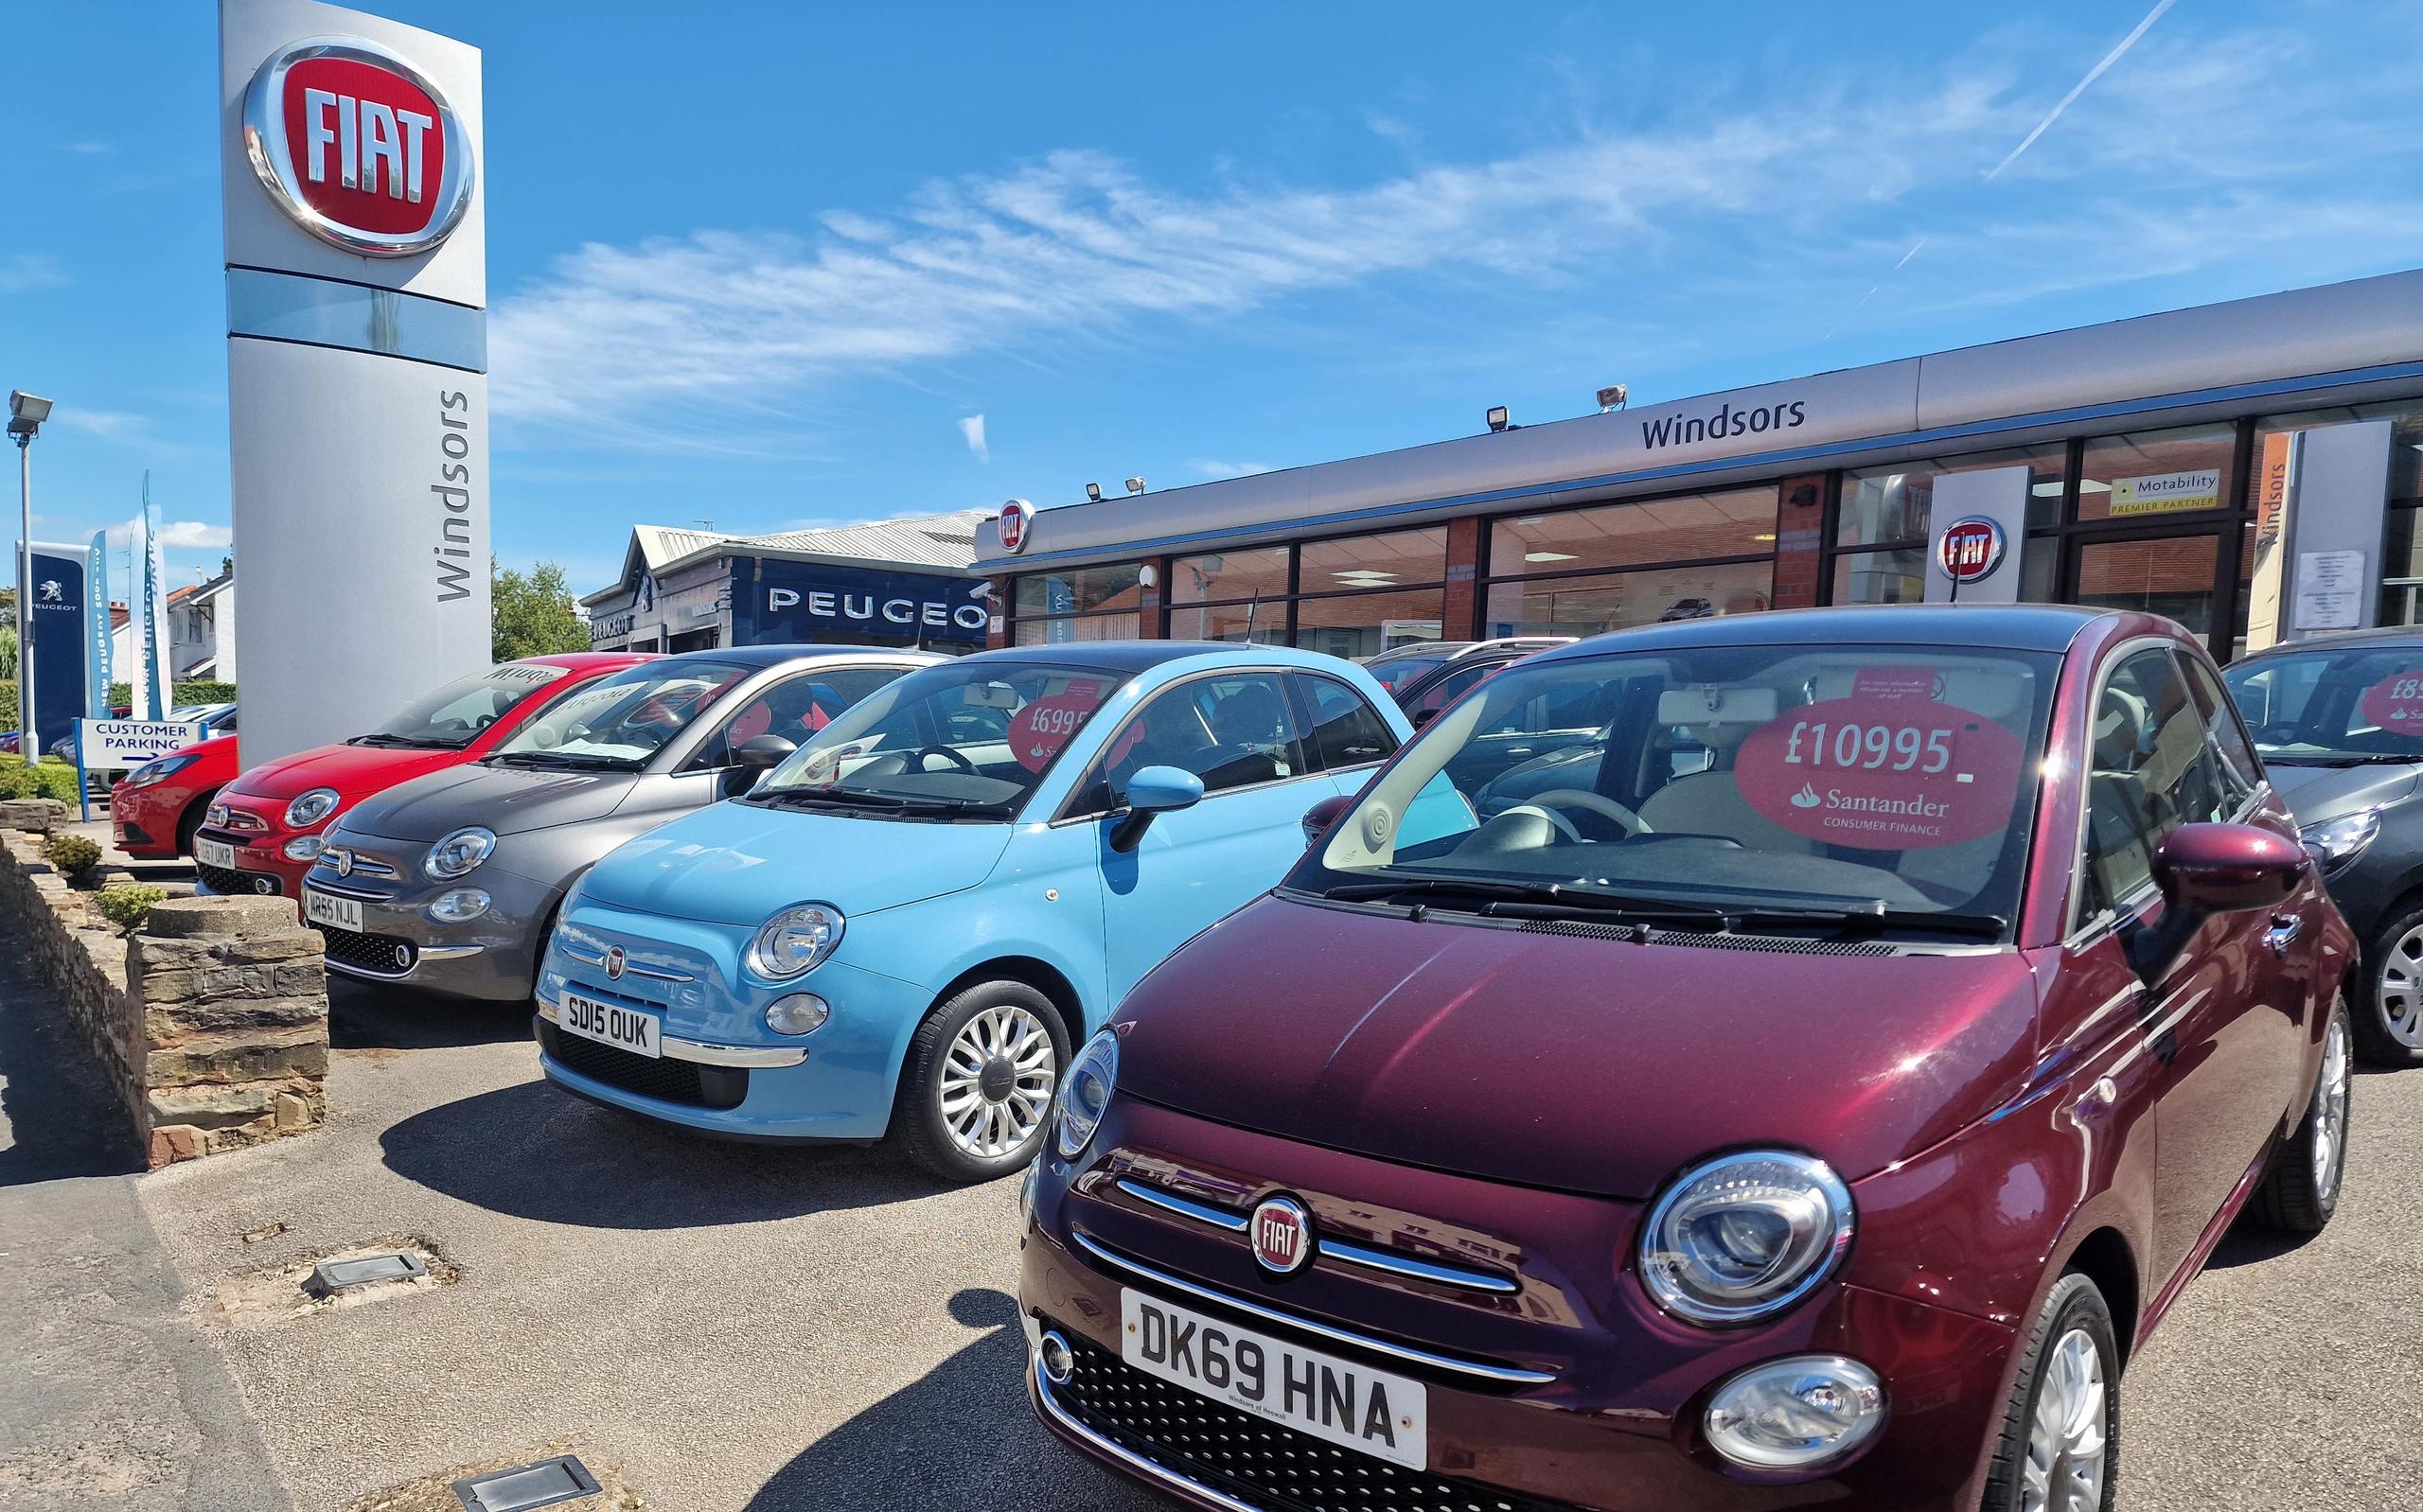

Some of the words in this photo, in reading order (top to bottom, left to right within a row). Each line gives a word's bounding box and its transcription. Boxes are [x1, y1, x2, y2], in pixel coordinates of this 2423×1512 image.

[305, 87, 433, 204] FIAT
[1642, 400, 1805, 449] Windsors
[431, 390, 470, 603] Windsors
[2138, 475, 2216, 493] Motability
[2111, 502, 2158, 514] PREMIER
[2163, 498, 2214, 509] PARTNER
[1002, 513, 1019, 539] FIAT
[32, 603, 78, 612] EUGEOT
[769, 588, 987, 629] PEUGEO
[96, 723, 188, 737] CUSTOMER
[106, 737, 180, 750] PARKING
[1784, 721, 1954, 773] £10995
[1826, 788, 1951, 818] Santander
[1824, 817, 1886, 833] CONSUMER
[1890, 821, 1941, 836] FINANCE
[215, 846, 232, 866] UKR
[335, 901, 358, 926] NJL
[569, 996, 605, 1035] SD15
[610, 1009, 647, 1048] OUK
[1262, 1220, 1296, 1257] FIAT
[1140, 1302, 1265, 1402] DK69
[1283, 1353, 1396, 1450] HNA
